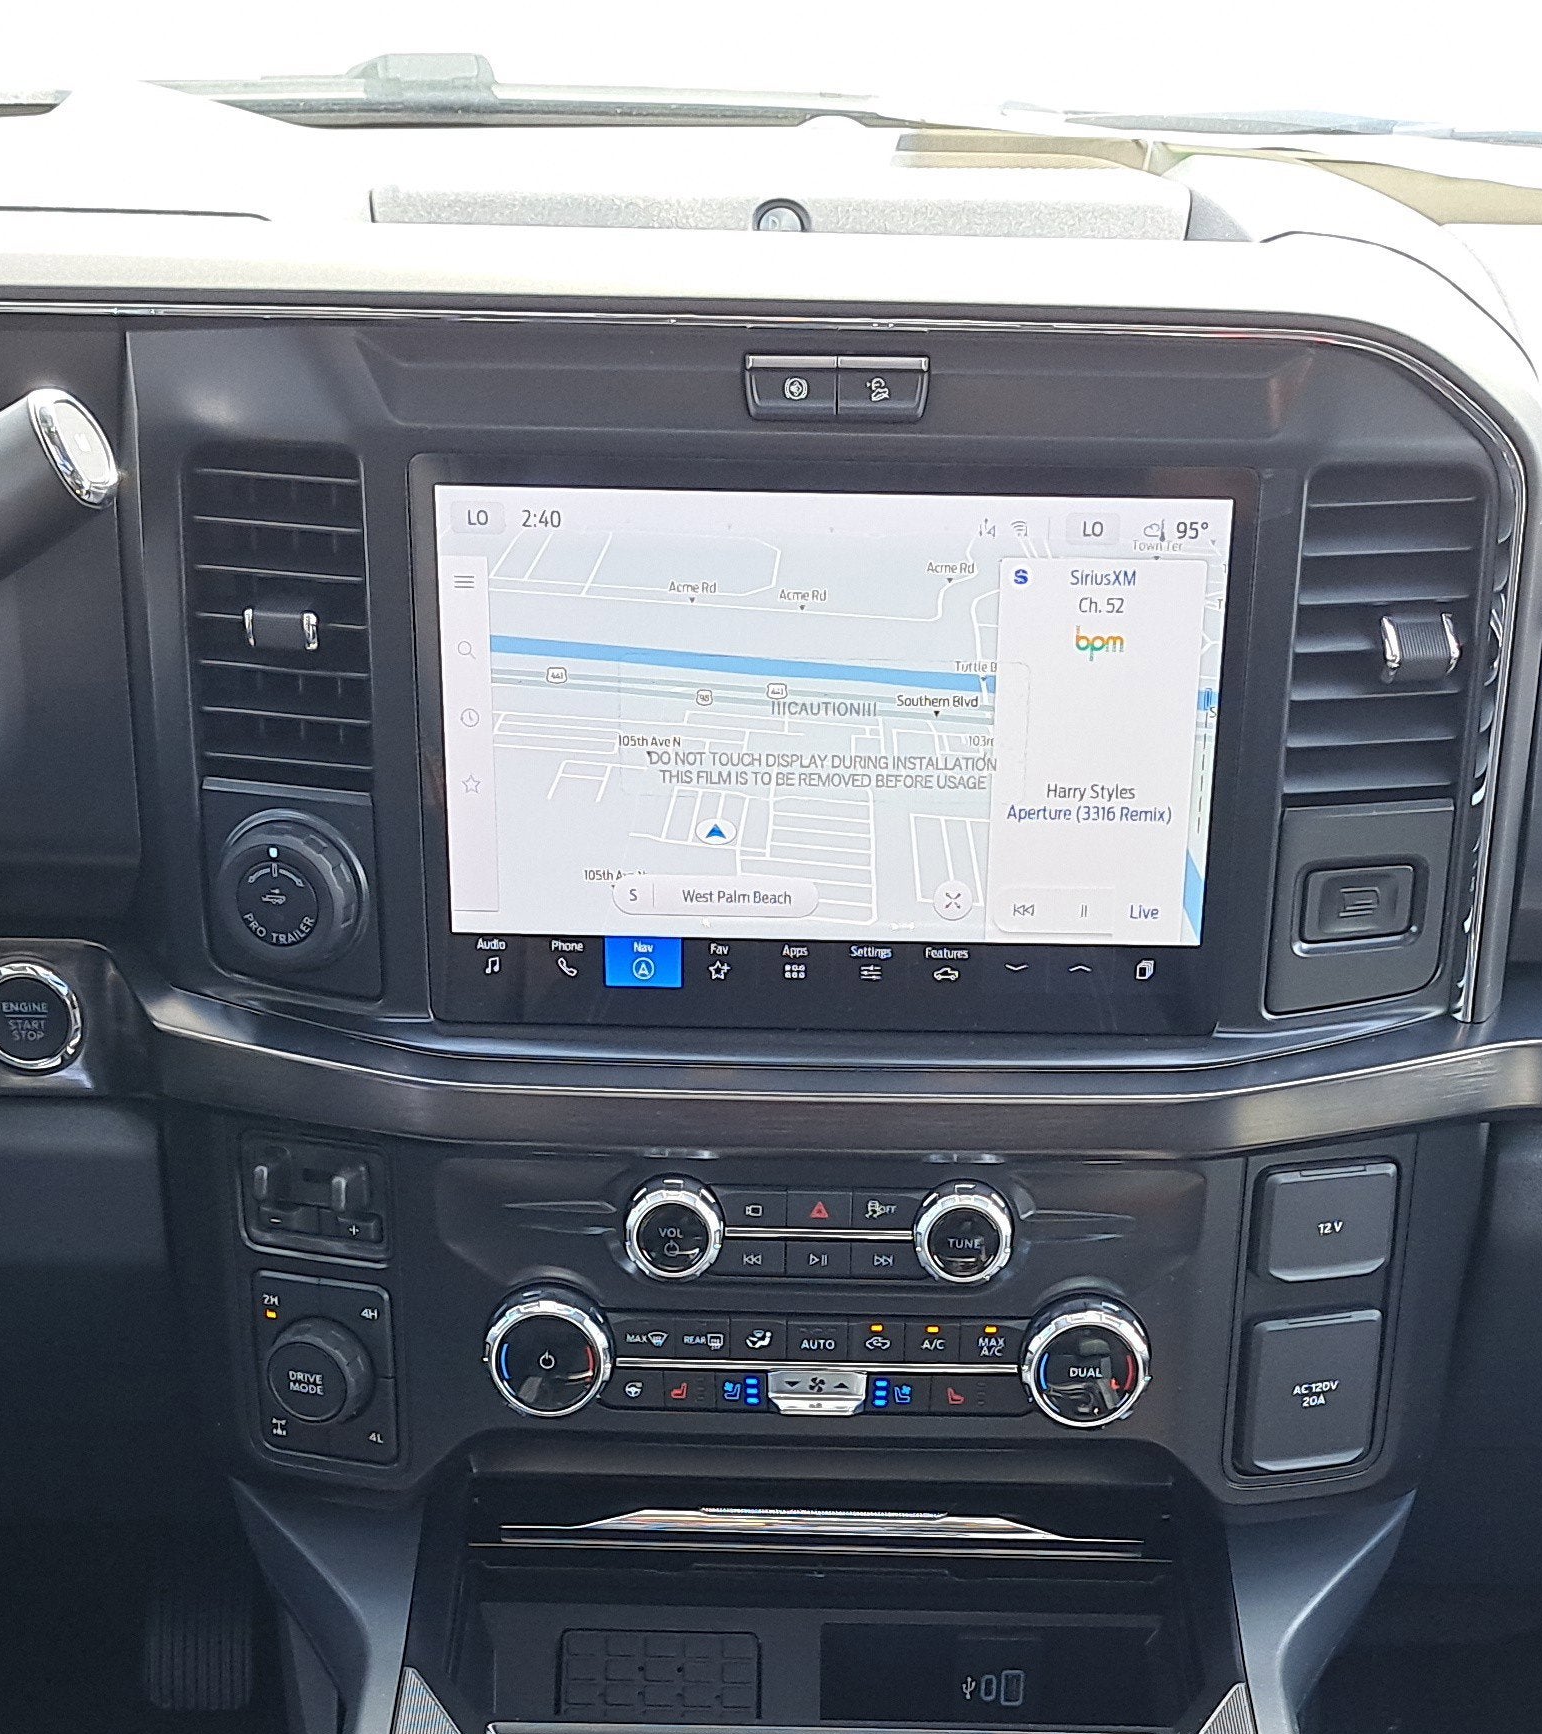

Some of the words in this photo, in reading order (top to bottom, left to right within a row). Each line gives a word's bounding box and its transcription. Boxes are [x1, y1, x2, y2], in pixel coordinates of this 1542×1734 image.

[467, 510, 488, 526] LO
[522, 510, 561, 528] 2:40
[1083, 521, 1103, 537] LO
[1176, 521, 1208, 539] 95°
[960, 563, 974, 574] Rd
[1070, 570, 1136, 586] SiriusXM
[702, 582, 716, 594] Rd
[812, 590, 827, 601] Rd
[1079, 598, 1101, 614] Ch.
[1107, 598, 1124, 614] 52
[1075, 625, 1125, 661] bpm
[897, 695, 949, 708] Southern
[952, 695, 978, 708] Blvd
[618, 734, 649, 747] 105th
[673, 736, 681, 748] N
[649, 751, 671, 765] DO
[675, 752, 706, 767] NOT
[710, 752, 761, 767] TOUCH
[765, 754, 828, 769] DISPLAY
[830, 755, 889, 770] DURING
[892, 756, 997, 772] INSTALLATION
[659, 769, 693, 784] THIS
[696, 770, 731, 785] FILM
[736, 772, 748, 786] IS
[751, 772, 771, 786] TO
[776, 773, 795, 787] BE
[798, 773, 872, 788] REMOVED
[875, 774, 933, 789] BEFORE
[937, 775, 987, 790] USAGE
[1046, 783, 1087, 801] Harry
[1090, 784, 1135, 800] Styles
[1007, 805, 1072, 823] Aperture
[1076, 805, 1115, 823] (3316
[1119, 806, 1172, 825] Remix)
[629, 889, 638, 902] S
[682, 890, 713, 903] West
[718, 890, 750, 904] Palm
[753, 891, 792, 905] Beach
[1130, 904, 1159, 920] Live
[243, 912, 267, 938] PRO
[271, 916, 316, 945] TRAILER
[477, 938, 506, 950] Audio
[551, 940, 584, 952] Phone
[633, 941, 654, 953] Nav
[710, 943, 729, 955] Fav
[782, 944, 809, 958] Apps
[850, 945, 892, 959] Settings
[925, 947, 969, 959] Features
[2, 1002, 48, 1013] ENGINE
[9, 1020, 45, 1030] START
[12, 1030, 44, 1041] STOP
[659, 1227, 683, 1238] VOL
[1318, 1223, 1332, 1236] 12
[947, 1237, 981, 1249] TUNE
[263, 1294, 279, 1306] 2H
[361, 1308, 378, 1320] 4H
[626, 1334, 647, 1344] MAX
[684, 1335, 706, 1345] REAR
[801, 1339, 836, 1350] AUTO
[921, 1338, 945, 1350] A/C
[978, 1337, 1005, 1347] MAX
[980, 1346, 1004, 1357] A/C
[288, 1371, 323, 1385] DRIVE
[1069, 1367, 1103, 1378] DUAL
[289, 1382, 324, 1396] MODE
[1293, 1384, 1309, 1395] AC
[1311, 1380, 1339, 1393] 120V
[1302, 1394, 1326, 1407] 20A
[368, 1432, 384, 1444] 4L
